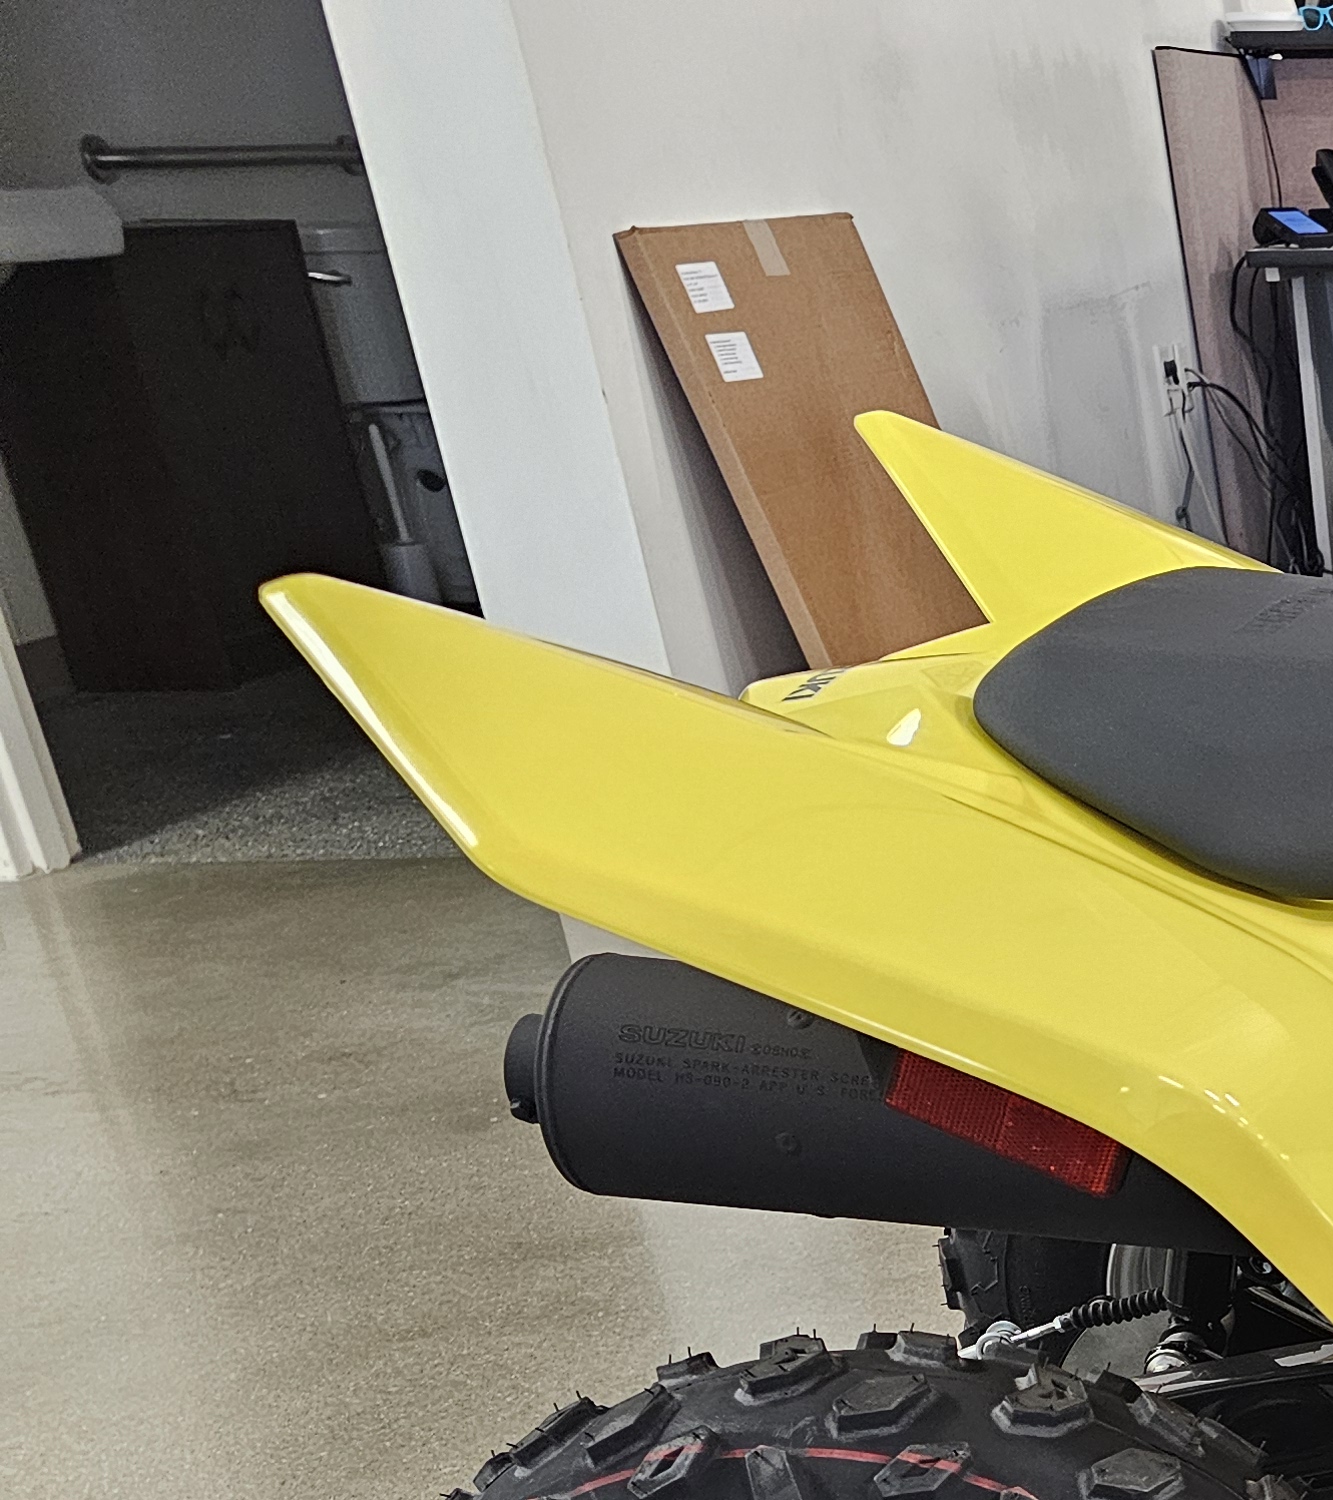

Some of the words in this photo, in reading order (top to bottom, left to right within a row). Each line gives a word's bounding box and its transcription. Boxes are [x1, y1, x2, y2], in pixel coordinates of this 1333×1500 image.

[618, 1023, 747, 1055] SUZUKI
[612, 1067, 665, 1084] MODEL
[613, 1052, 673, 1068] SUZUKI
[682, 1058, 827, 1082] SPARK-ARRESTER
